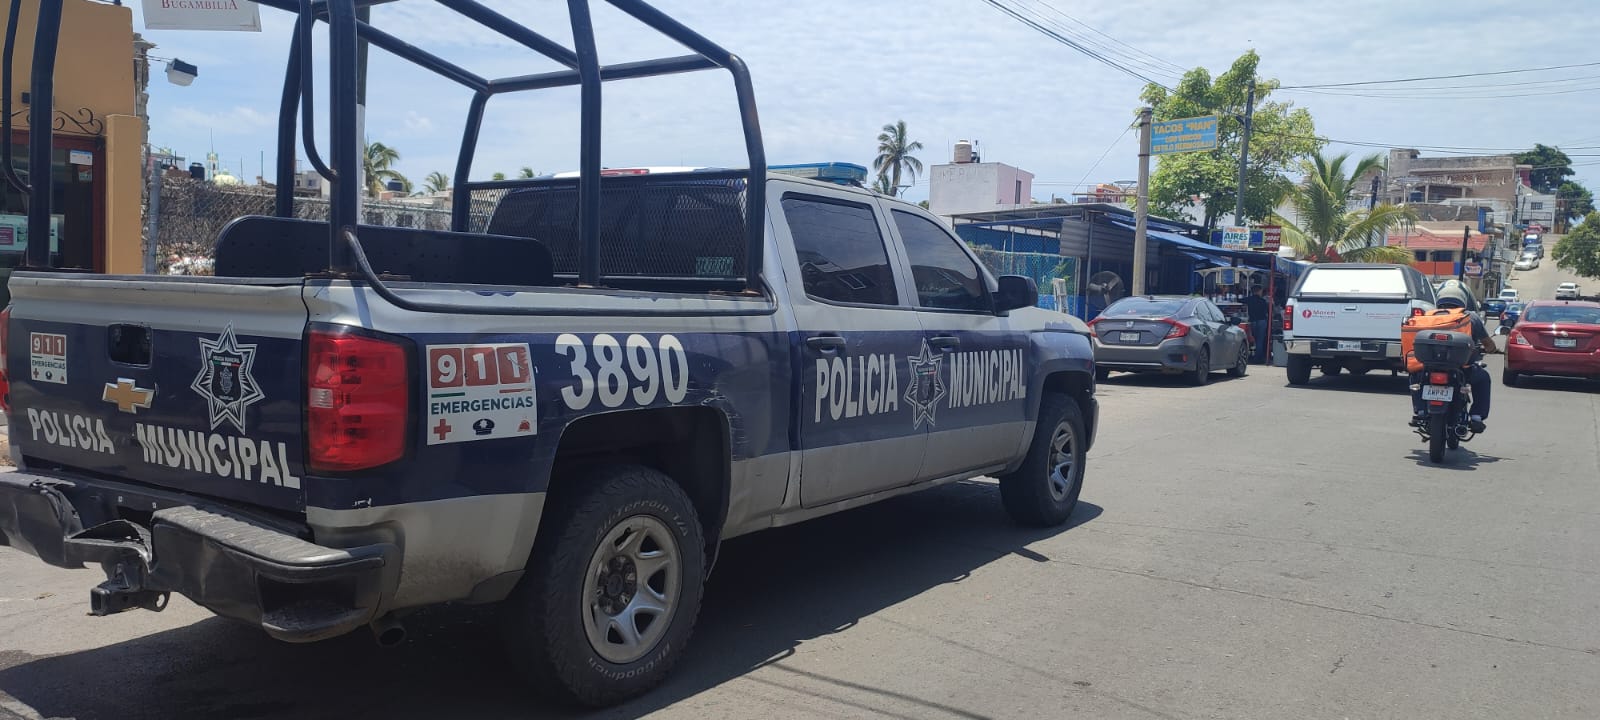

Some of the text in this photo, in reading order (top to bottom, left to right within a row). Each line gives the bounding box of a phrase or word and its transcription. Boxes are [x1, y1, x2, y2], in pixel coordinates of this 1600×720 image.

[1153, 123, 1184, 134] TACOS
[1223, 232, 1249, 241] AIRES
[32, 336, 64, 355] 911
[31, 359, 66, 370] EMERGENCIAS
[437, 352, 522, 383] 911
[554, 333, 690, 410] 3890
[815, 349, 1027, 423] POLICIA MUNICIPAL
[431, 396, 534, 415] EMERGENCIAS
[27, 407, 300, 490] POLICIA MUNICIPAL
